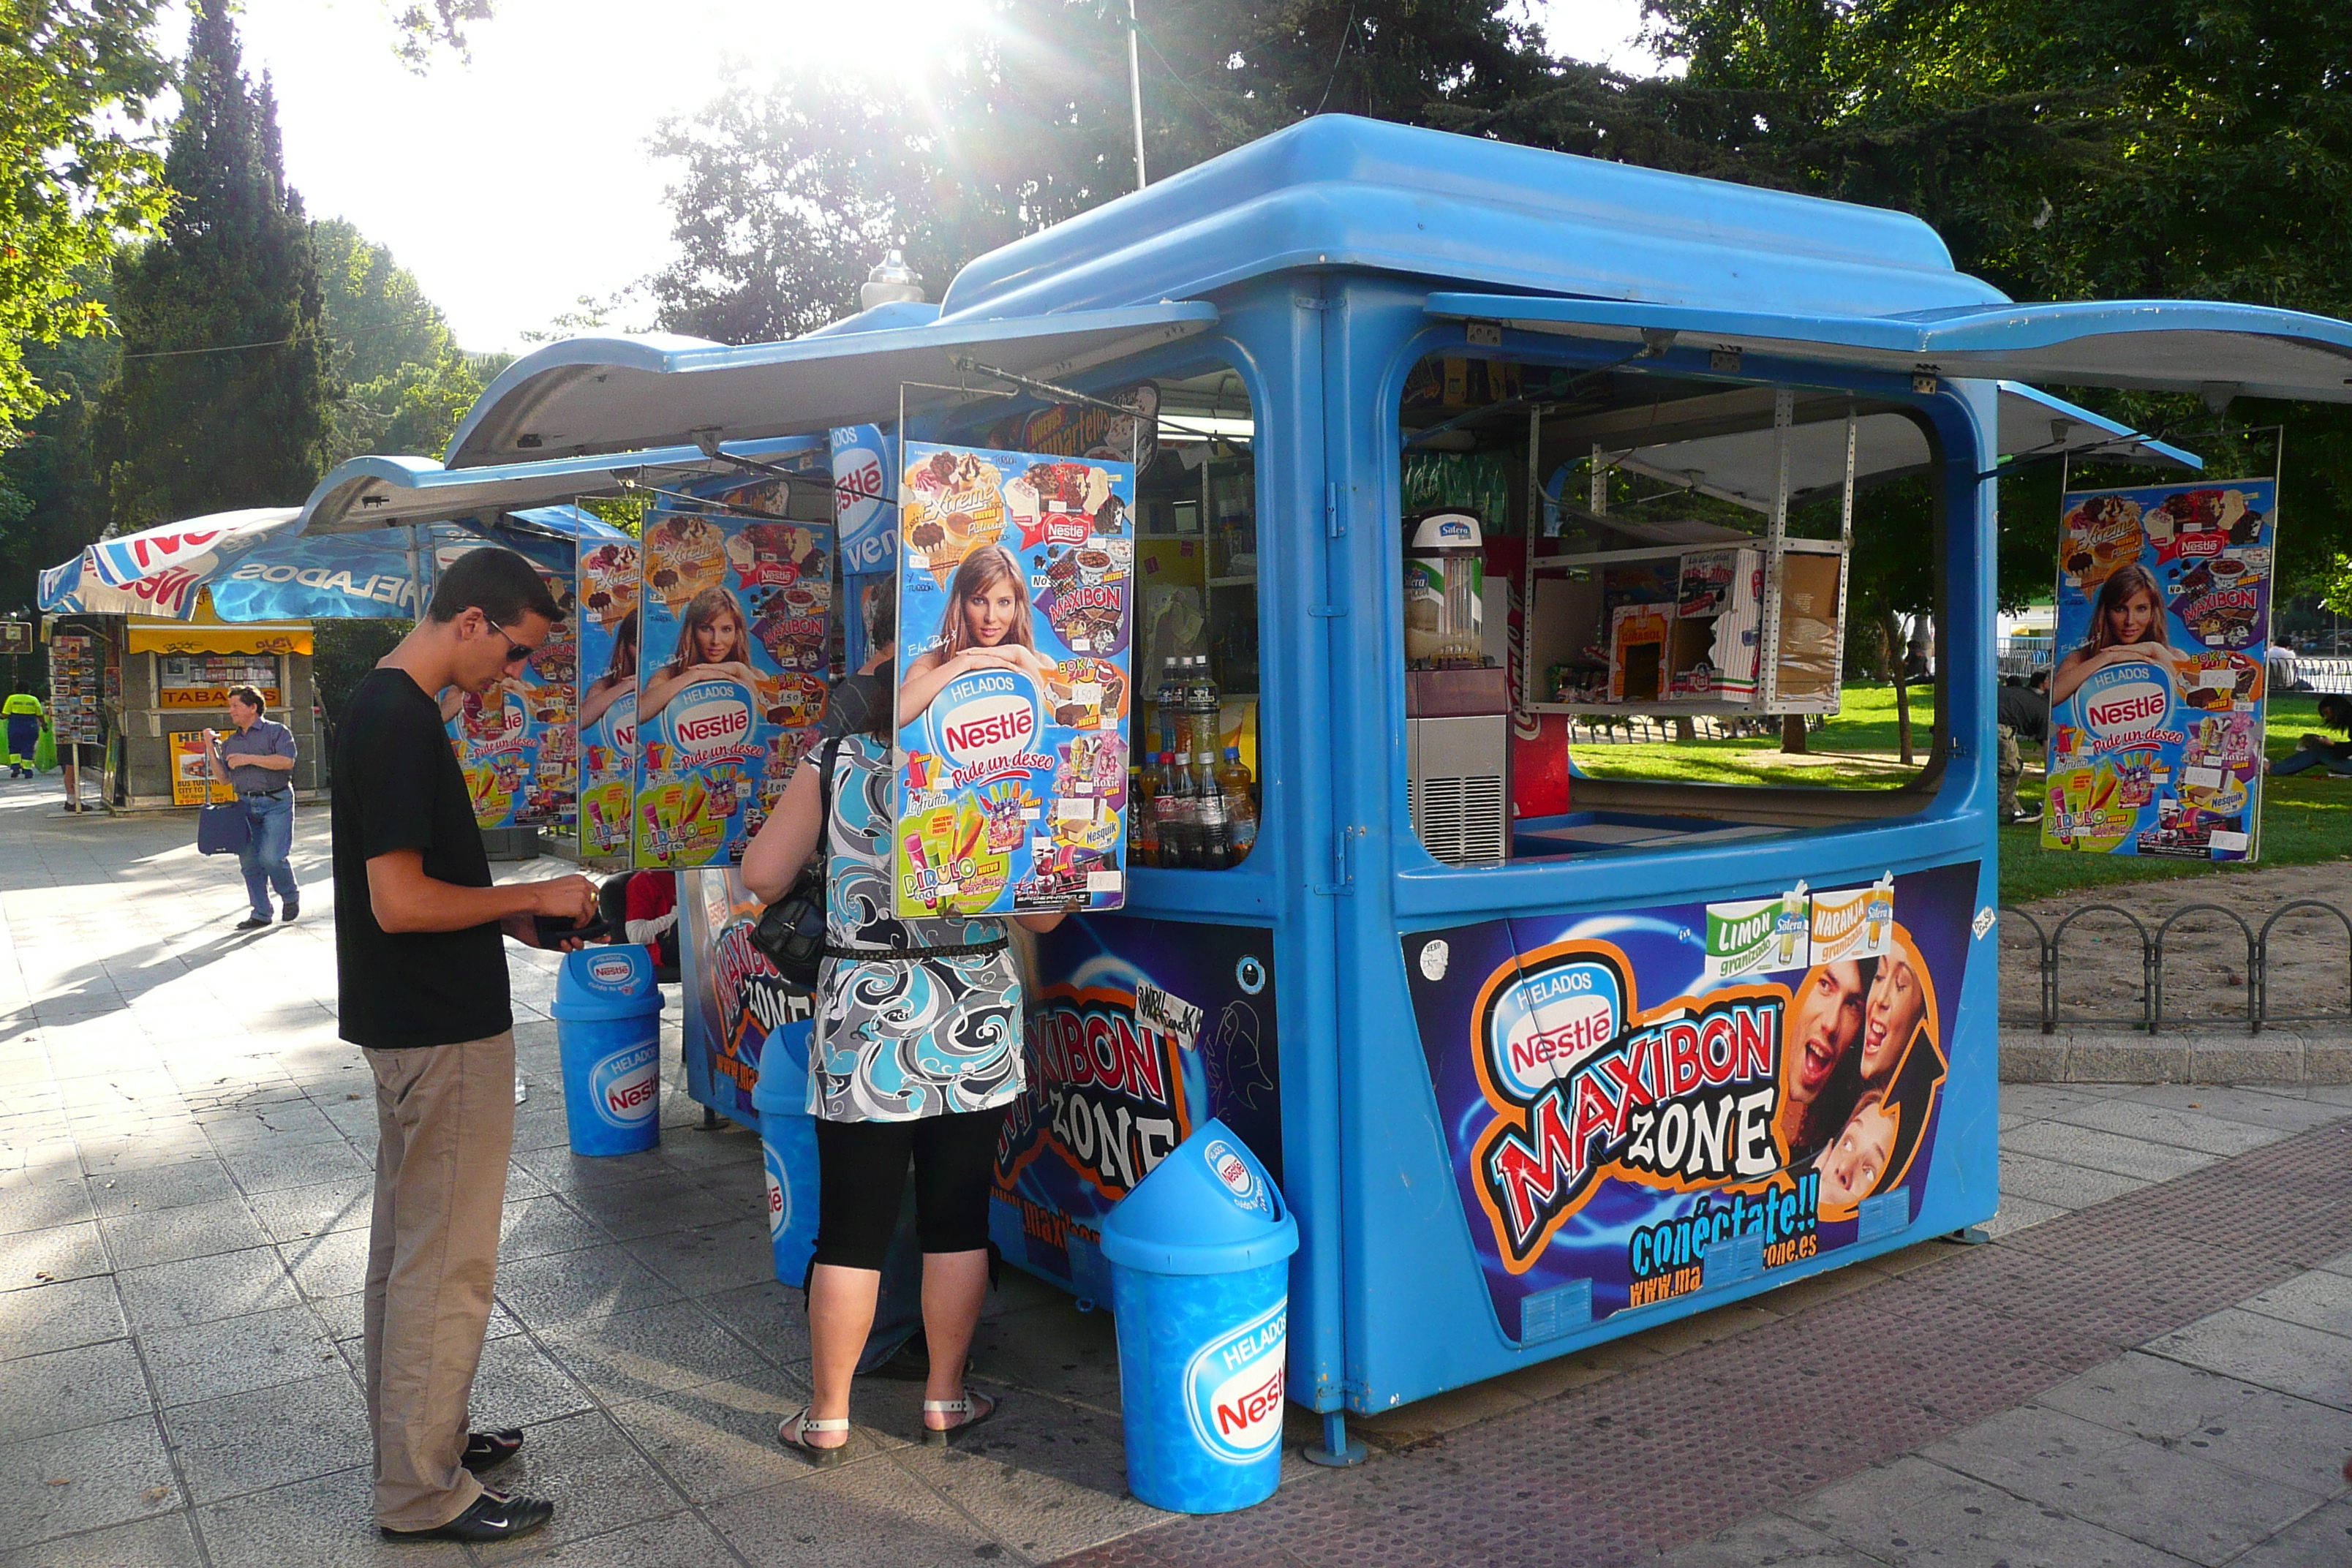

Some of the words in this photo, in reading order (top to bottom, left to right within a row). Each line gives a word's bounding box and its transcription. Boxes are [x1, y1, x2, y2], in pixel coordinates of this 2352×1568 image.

[1049, 585, 1122, 627] MAXIBON
[2183, 589, 2257, 624] MAXIBON
[764, 618, 824, 647] MAXIBON
[1058, 657, 1095, 674] BOKA
[2190, 651, 2228, 665] BOKA
[770, 672, 802, 684] BOKA
[951, 676, 1014, 702] HELADOS
[2095, 668, 2149, 688] HELADOS
[163, 691, 276, 704] TABAS
[683, 686, 734, 704] HELADOS
[1077, 716, 1098, 726] NUEVO
[2089, 693, 2165, 727] Nestlé
[678, 710, 747, 742] Nestlé
[946, 706, 1032, 753] Nestlé
[2092, 734, 2121, 755] Pide
[2124, 731, 2143, 745] un
[2145, 726, 2185, 744] deseo
[475, 743, 494, 758] Pide
[496, 740, 509, 750] un
[510, 736, 538, 747] deseo
[682, 750, 709, 769] Pide
[711, 746, 728, 757] un
[730, 741, 764, 756] deseo
[951, 761, 985, 788] Pide
[988, 755, 1010, 771] un
[1012, 749, 1054, 770] deseo
[2211, 792, 2244, 808] Nesquik
[1086, 821, 1117, 844] Nesquik
[978, 862, 998, 874] NUEVO
[1719, 911, 1771, 951] LIMON
[1814, 897, 1864, 938] NARANJA
[1719, 938, 1771, 976] granizado
[1822, 924, 1863, 962] granizada
[595, 965, 629, 977] Nestlé
[1516, 972, 1593, 1010] HELADOS
[1511, 1008, 1610, 1074] Nestlé
[1492, 1005, 1777, 1244] MAXIBON
[1627, 1087, 1779, 1176] ZONE
[1221, 1158, 1245, 1185] Nestlé
